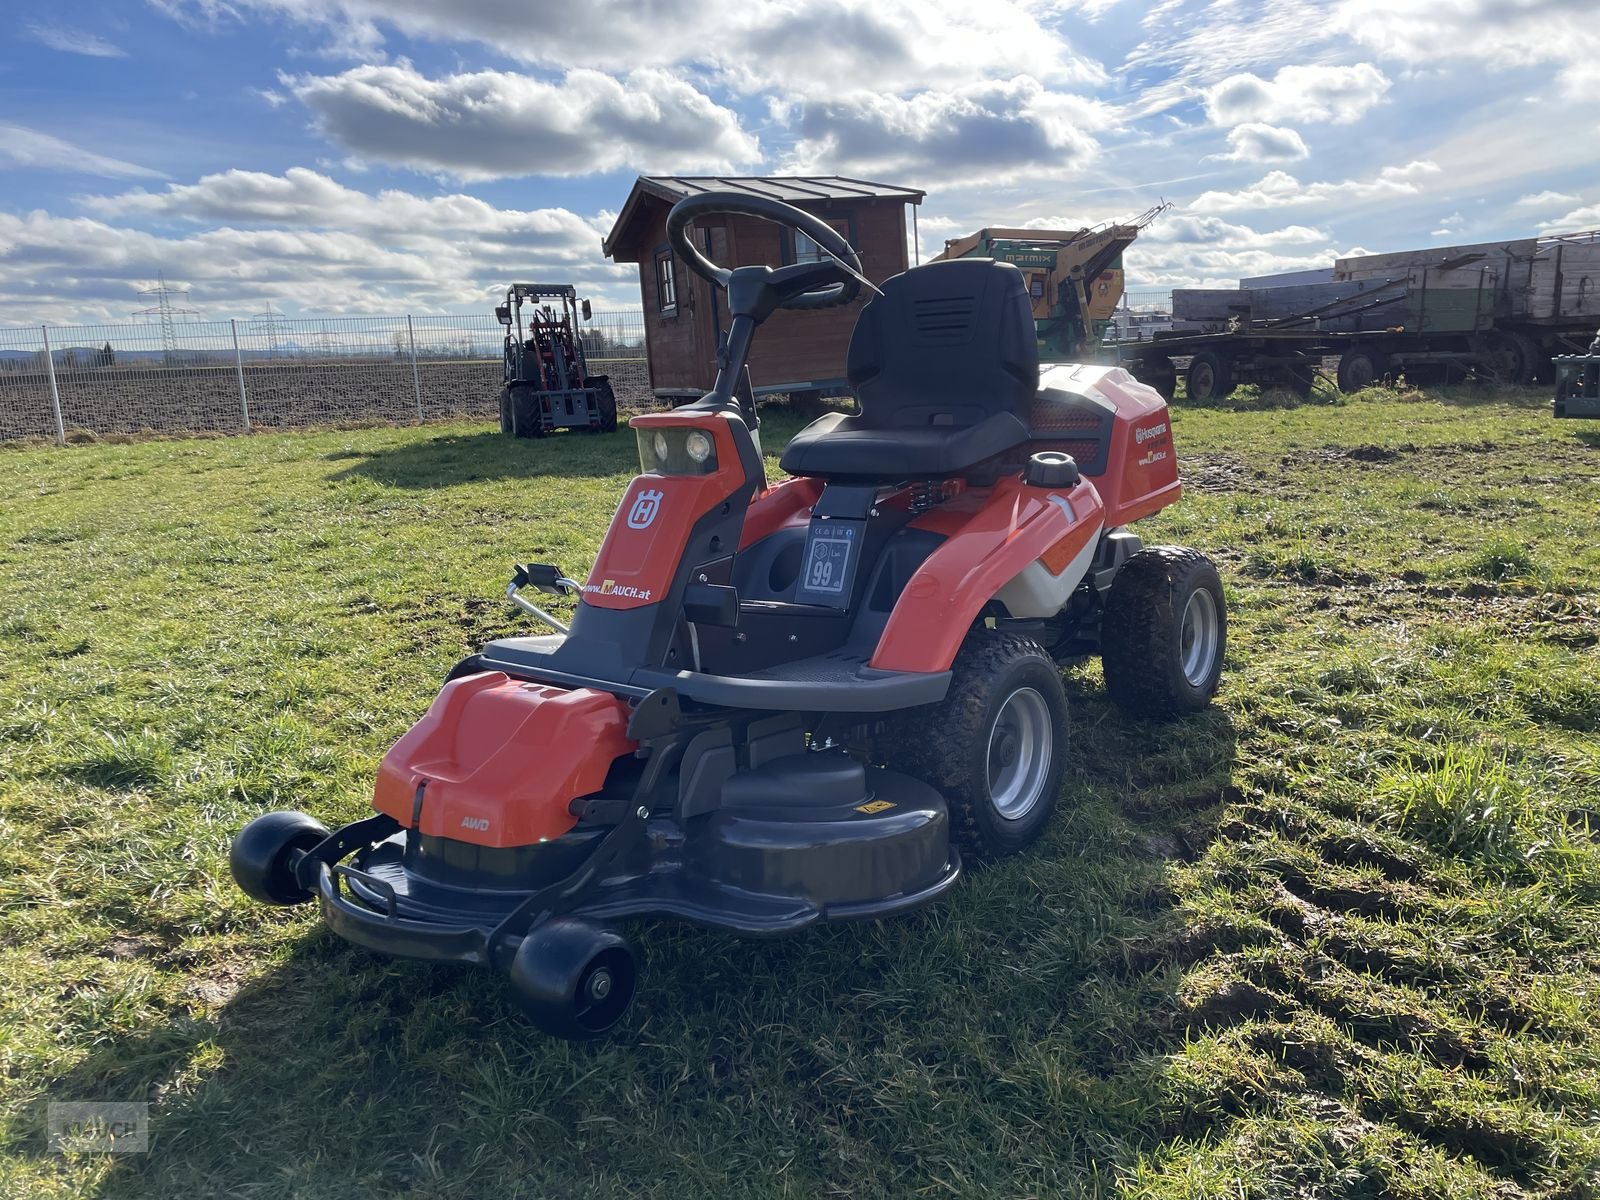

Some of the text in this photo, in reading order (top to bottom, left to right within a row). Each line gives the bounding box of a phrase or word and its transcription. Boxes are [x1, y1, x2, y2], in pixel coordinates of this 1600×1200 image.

[1005, 254, 1051, 263] marmix
[811, 560, 833, 587] 99
[460, 815, 490, 832] AWD
